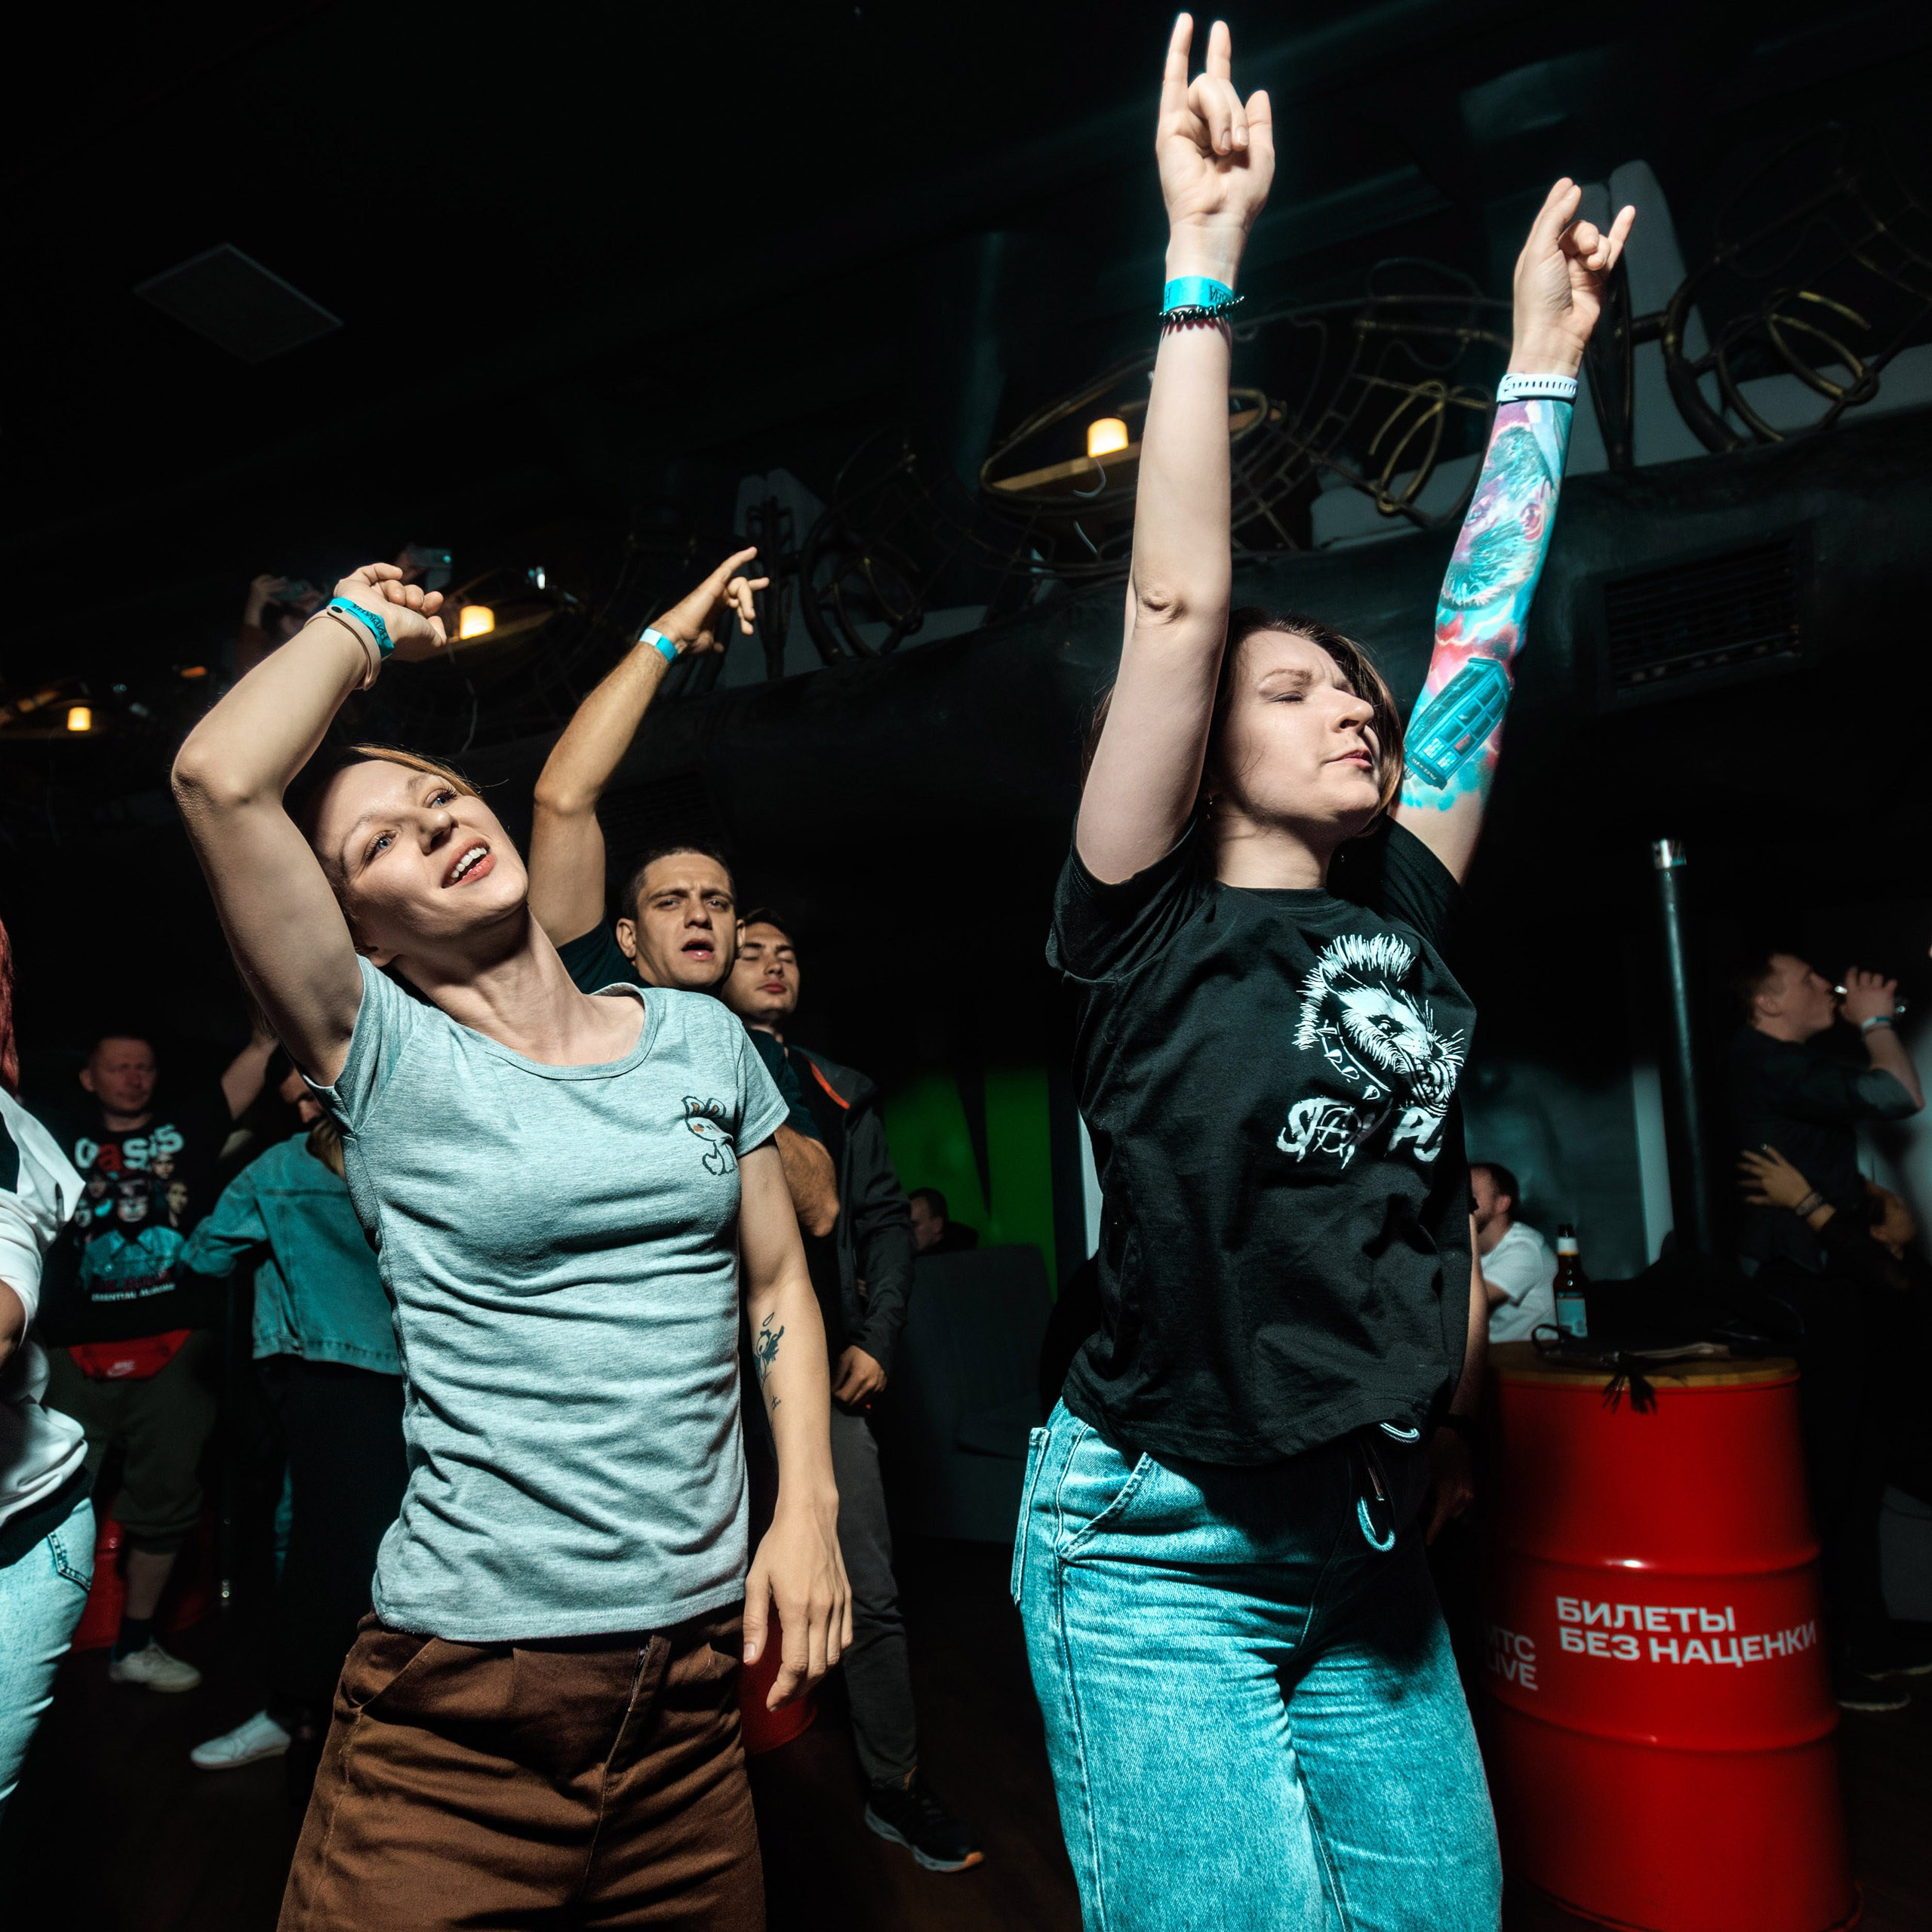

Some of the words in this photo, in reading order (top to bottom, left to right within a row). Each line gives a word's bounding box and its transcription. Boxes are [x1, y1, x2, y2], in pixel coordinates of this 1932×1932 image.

[1556, 1595, 1736, 1633] БИЛЕТЫ
[1559, 1626, 1641, 1661] БЕЗ
[1649, 1620, 1816, 1668] НАЦЕНКИ
